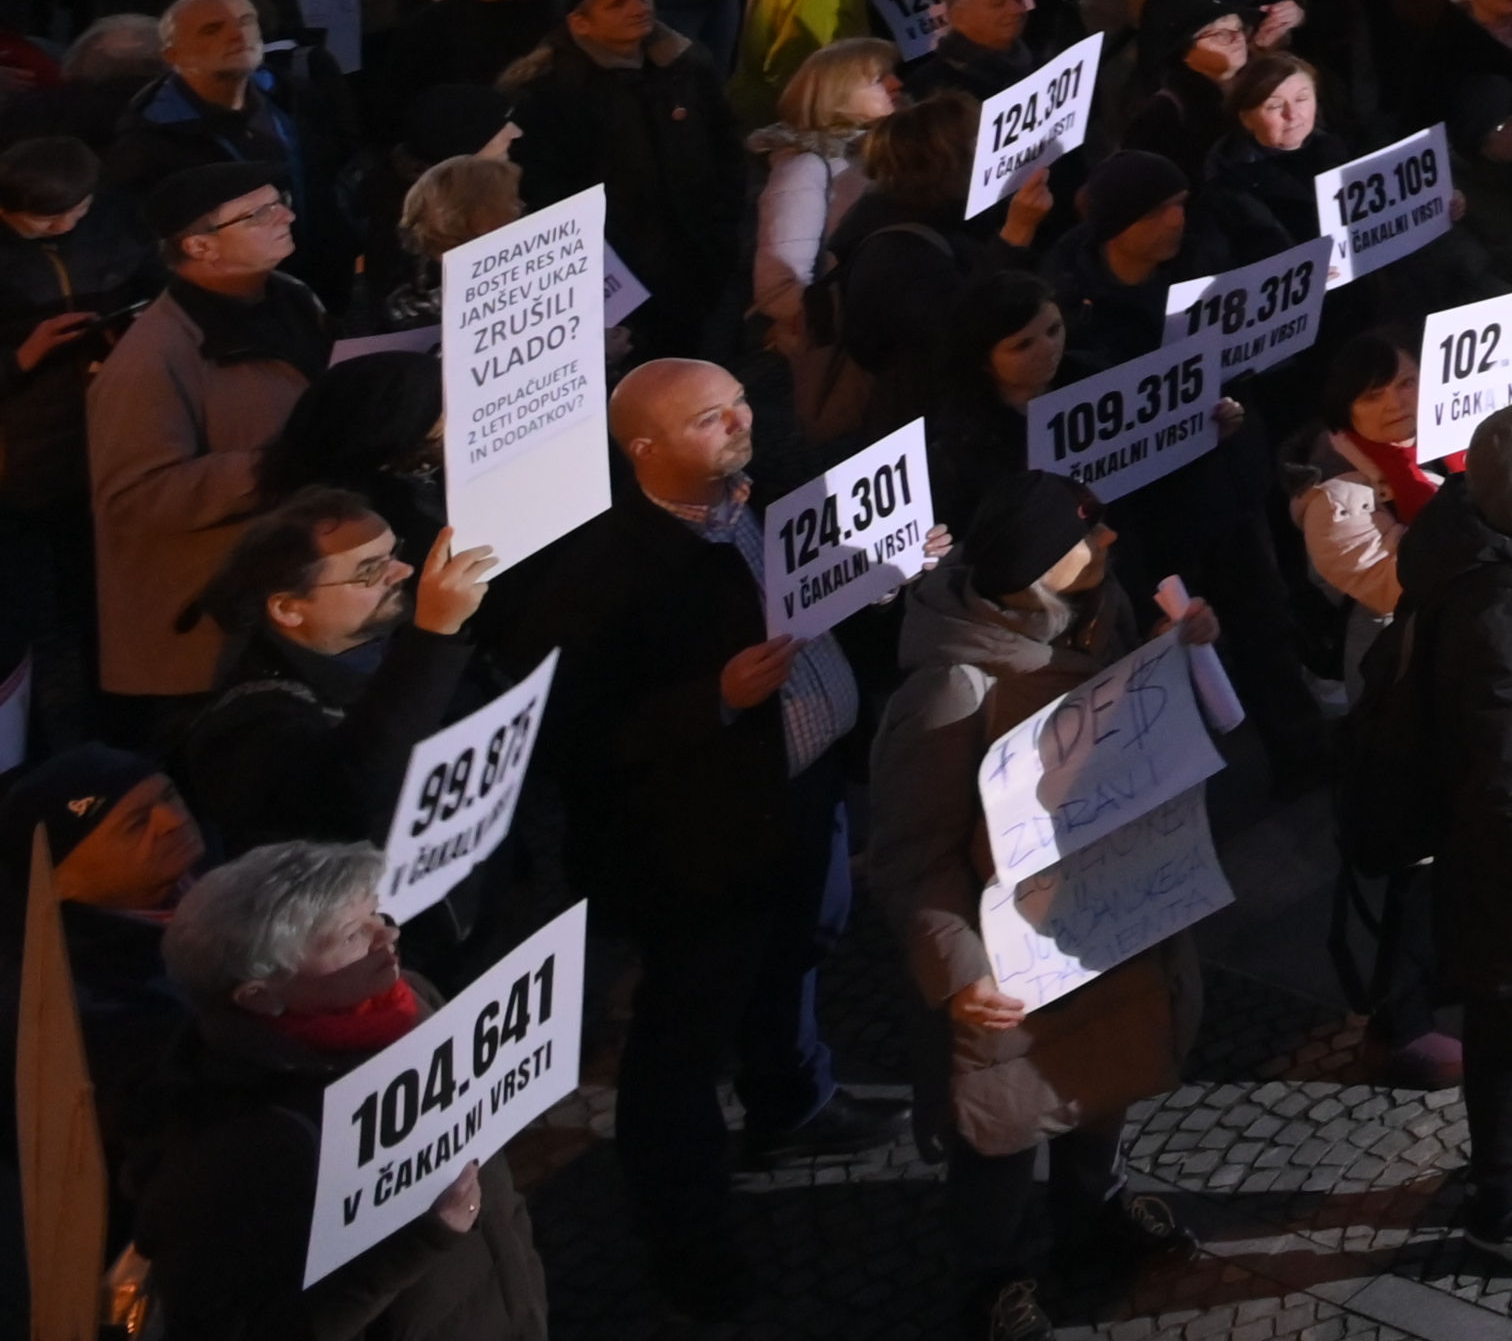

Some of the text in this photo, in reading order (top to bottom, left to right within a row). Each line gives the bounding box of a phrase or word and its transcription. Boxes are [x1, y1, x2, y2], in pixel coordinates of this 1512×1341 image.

[991, 60, 1084, 153] 124.301
[984, 167, 992, 186] V
[1333, 149, 1437, 227] 123.109
[472, 219, 581, 278] ZDRAVNIKI,
[1352, 214, 1408, 255] ČAKALNI
[1410, 196, 1444, 232] VRSTI
[460, 256, 588, 328] JANŠEV UKAZ
[465, 239, 585, 303] BOSTE RES NA
[1185, 260, 1314, 336] 118.313
[471, 316, 581, 387] VLADO?
[474, 288, 575, 353] ZRUŠILI
[1221, 313, 1308, 369] KALNI VRSTI
[472, 362, 579, 423] ODPLAČUJETE
[480, 413, 512, 443] LETI
[517, 374, 588, 418] DOPUSTA
[1047, 354, 1203, 462] 109.315
[1434, 403, 1444, 426] V
[470, 394, 585, 465] IN DODATKOV?
[1156, 410, 1204, 453] VRSTI
[779, 453, 912, 575] 124.301
[783, 519, 921, 620] V ČAKALNI VRSTI
[352, 954, 556, 1169] 104.641
[344, 1040, 553, 1226] V ČAKALNI VRSTI
